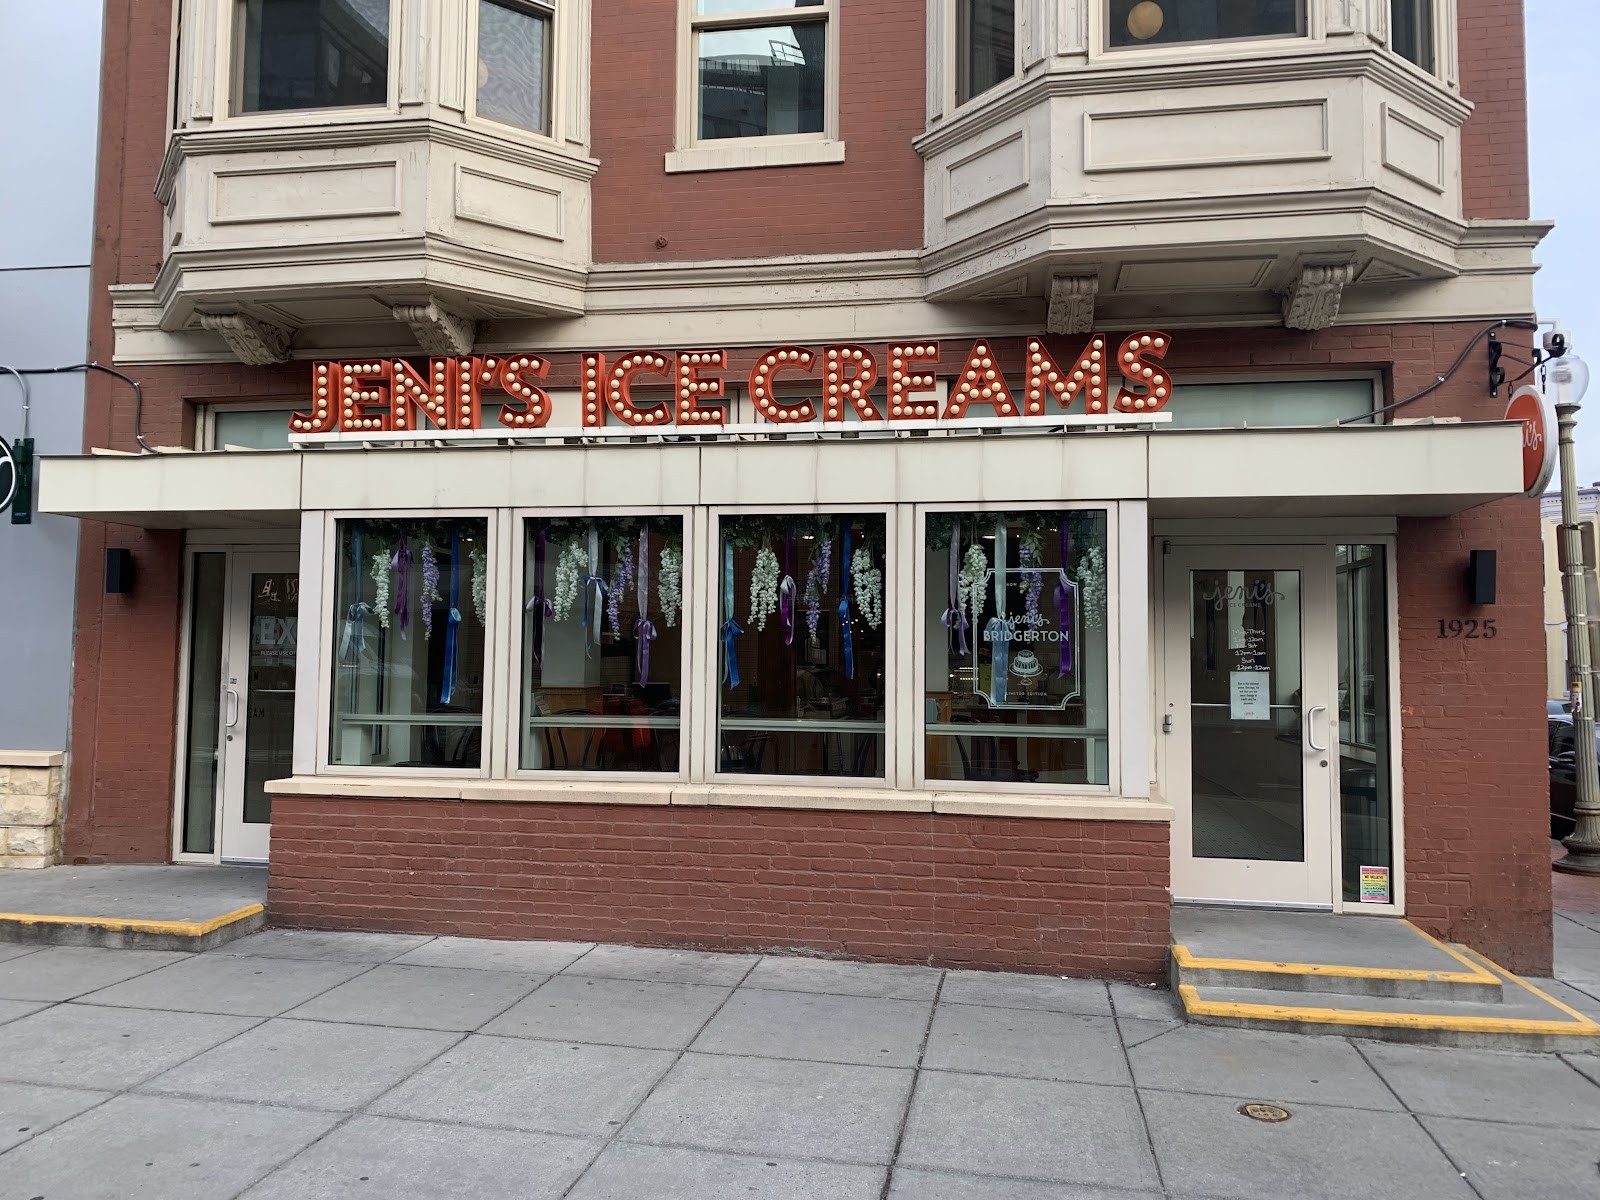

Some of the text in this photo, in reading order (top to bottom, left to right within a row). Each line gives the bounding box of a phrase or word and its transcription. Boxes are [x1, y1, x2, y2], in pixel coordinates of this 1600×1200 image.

[288, 331, 1173, 433] JENI'S ICE CREAMS
[1523, 420, 1542, 451] i's
[983, 630, 1069, 642] BRIDGERTON
[1437, 618, 1497, 639] 1925
